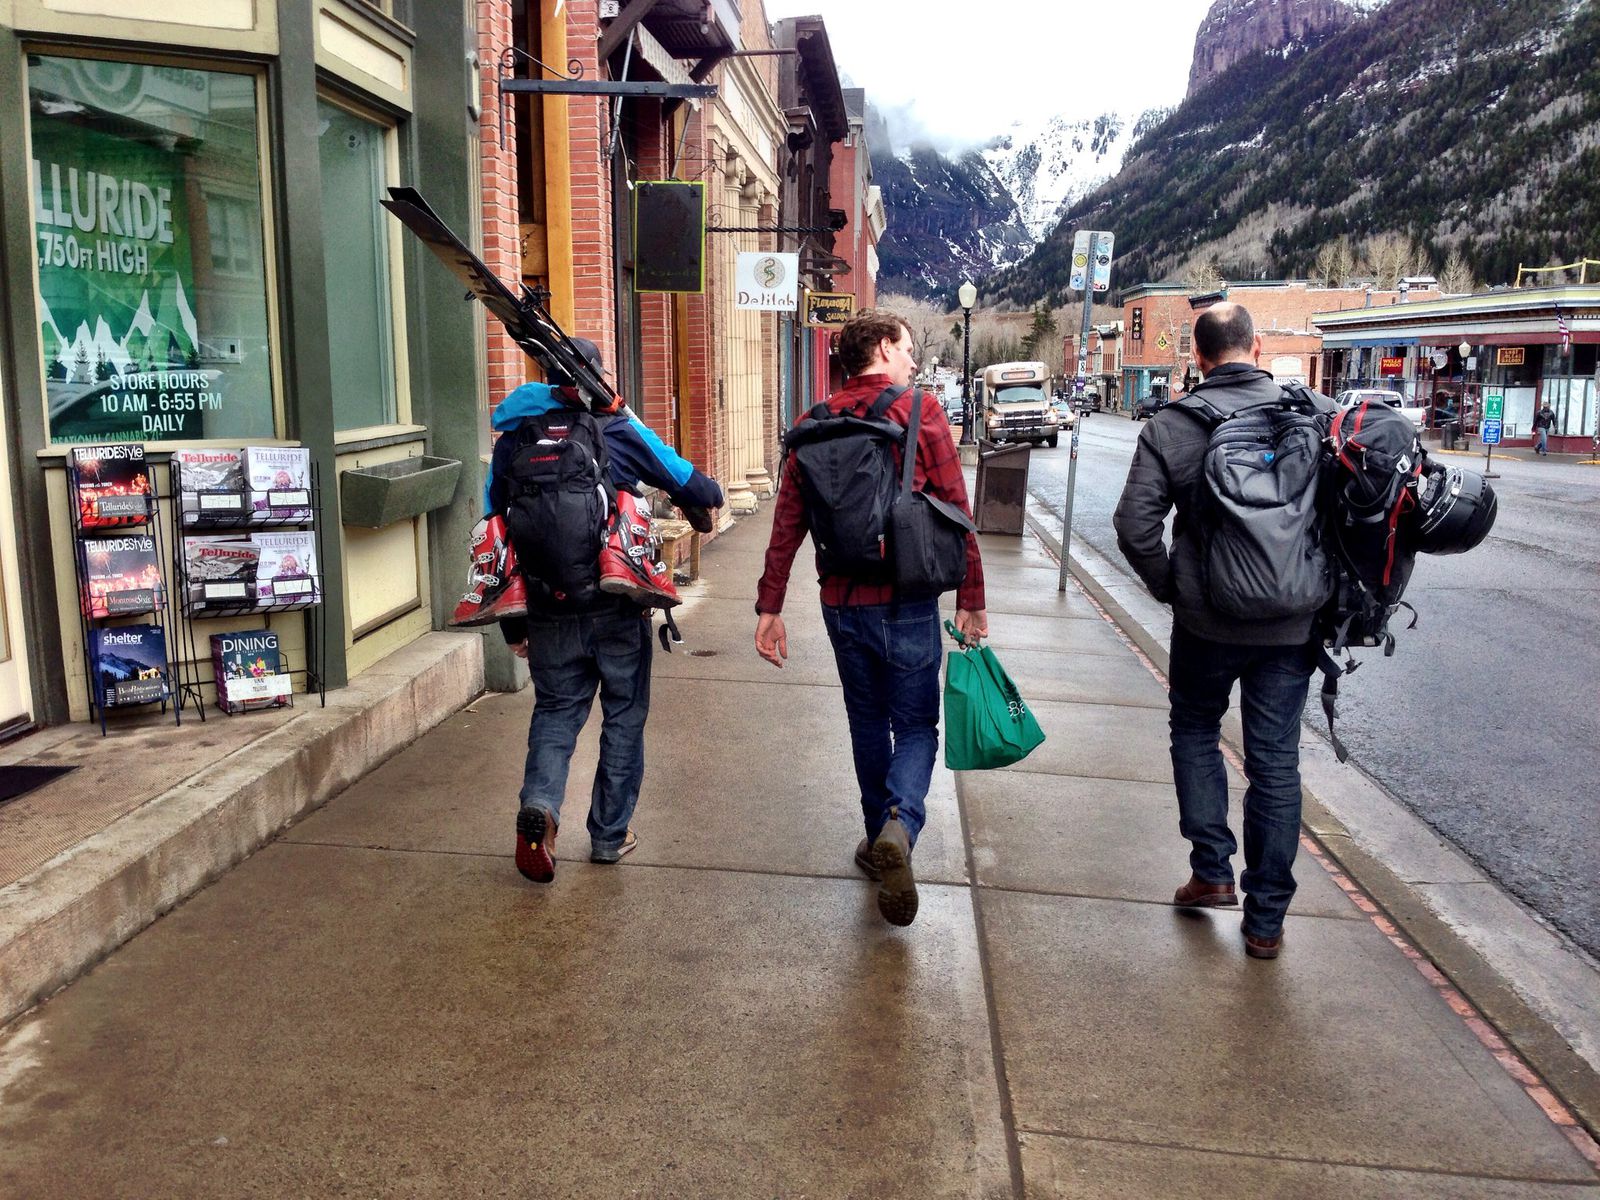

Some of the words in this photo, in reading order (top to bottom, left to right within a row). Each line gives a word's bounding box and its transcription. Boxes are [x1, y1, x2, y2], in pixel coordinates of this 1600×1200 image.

[96, 240, 148, 275] HIGH
[738, 291, 795, 306] Delilah
[110, 374, 156, 390] STORE
[158, 373, 210, 390] HOURS
[100, 394, 119, 413] 10
[122, 394, 148, 412] AM
[159, 393, 195, 411] 6:55
[198, 392, 223, 410] PM
[142, 414, 185, 432] DAILY
[105, 431, 148, 443] CANNABIS
[74, 446, 143, 460] TELLURIDEStyle
[181, 453, 238, 463] Telluride
[255, 452, 303, 462] TELLURIDE
[85, 538, 153, 552] TELLURIDEStyle
[260, 537, 309, 546] TELLURIDE
[199, 548, 257, 559] Telluride
[103, 632, 143, 644] shelter
[222, 636, 277, 652] DINING
